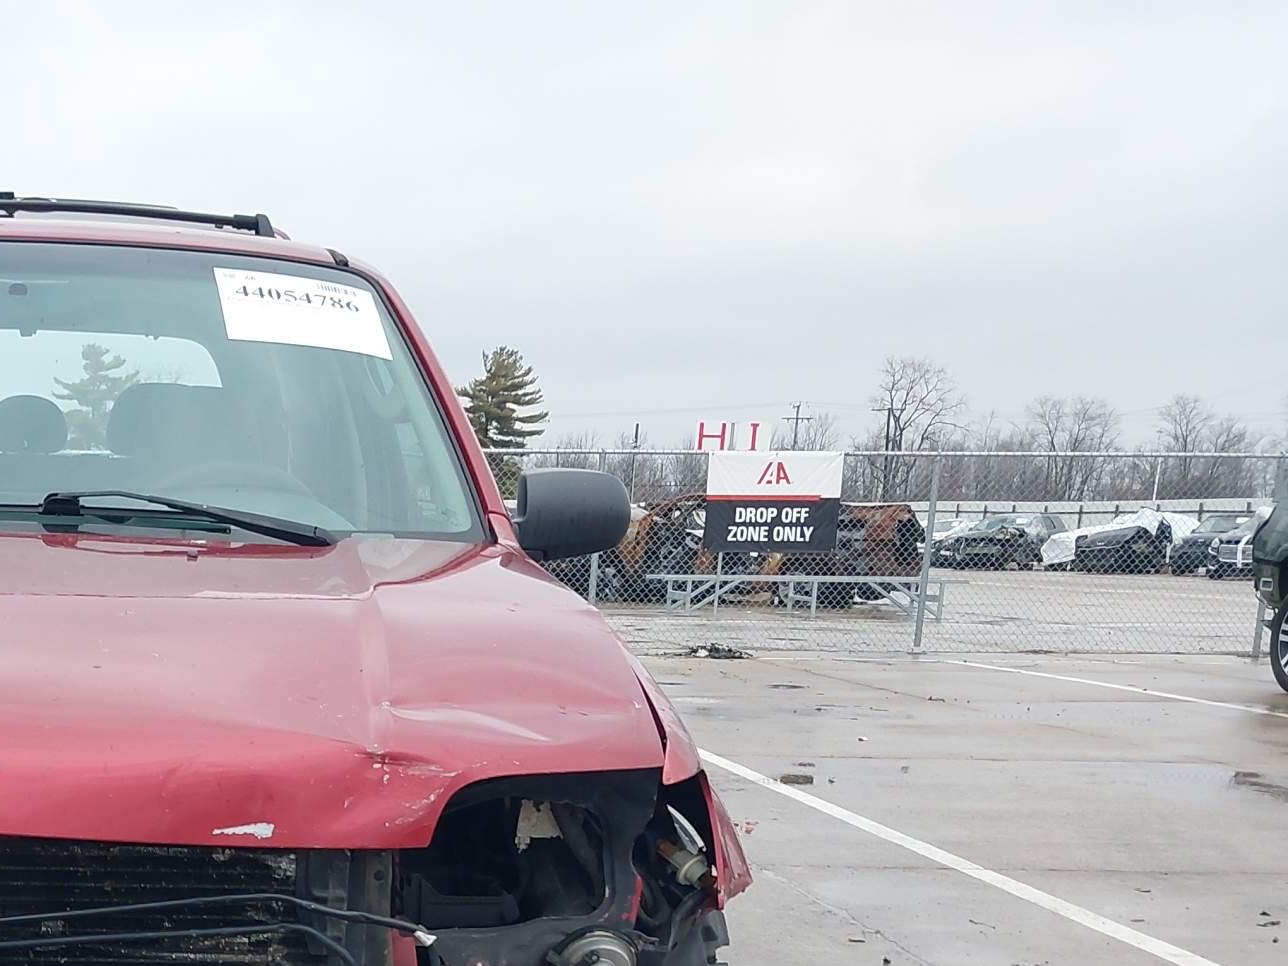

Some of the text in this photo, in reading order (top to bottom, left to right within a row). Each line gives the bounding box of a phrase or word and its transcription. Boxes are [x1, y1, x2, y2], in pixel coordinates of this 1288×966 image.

[235, 285, 360, 313] 44054786
[734, 507, 810, 523] DROP OFF
[726, 526, 814, 542] ZONE ONLY
